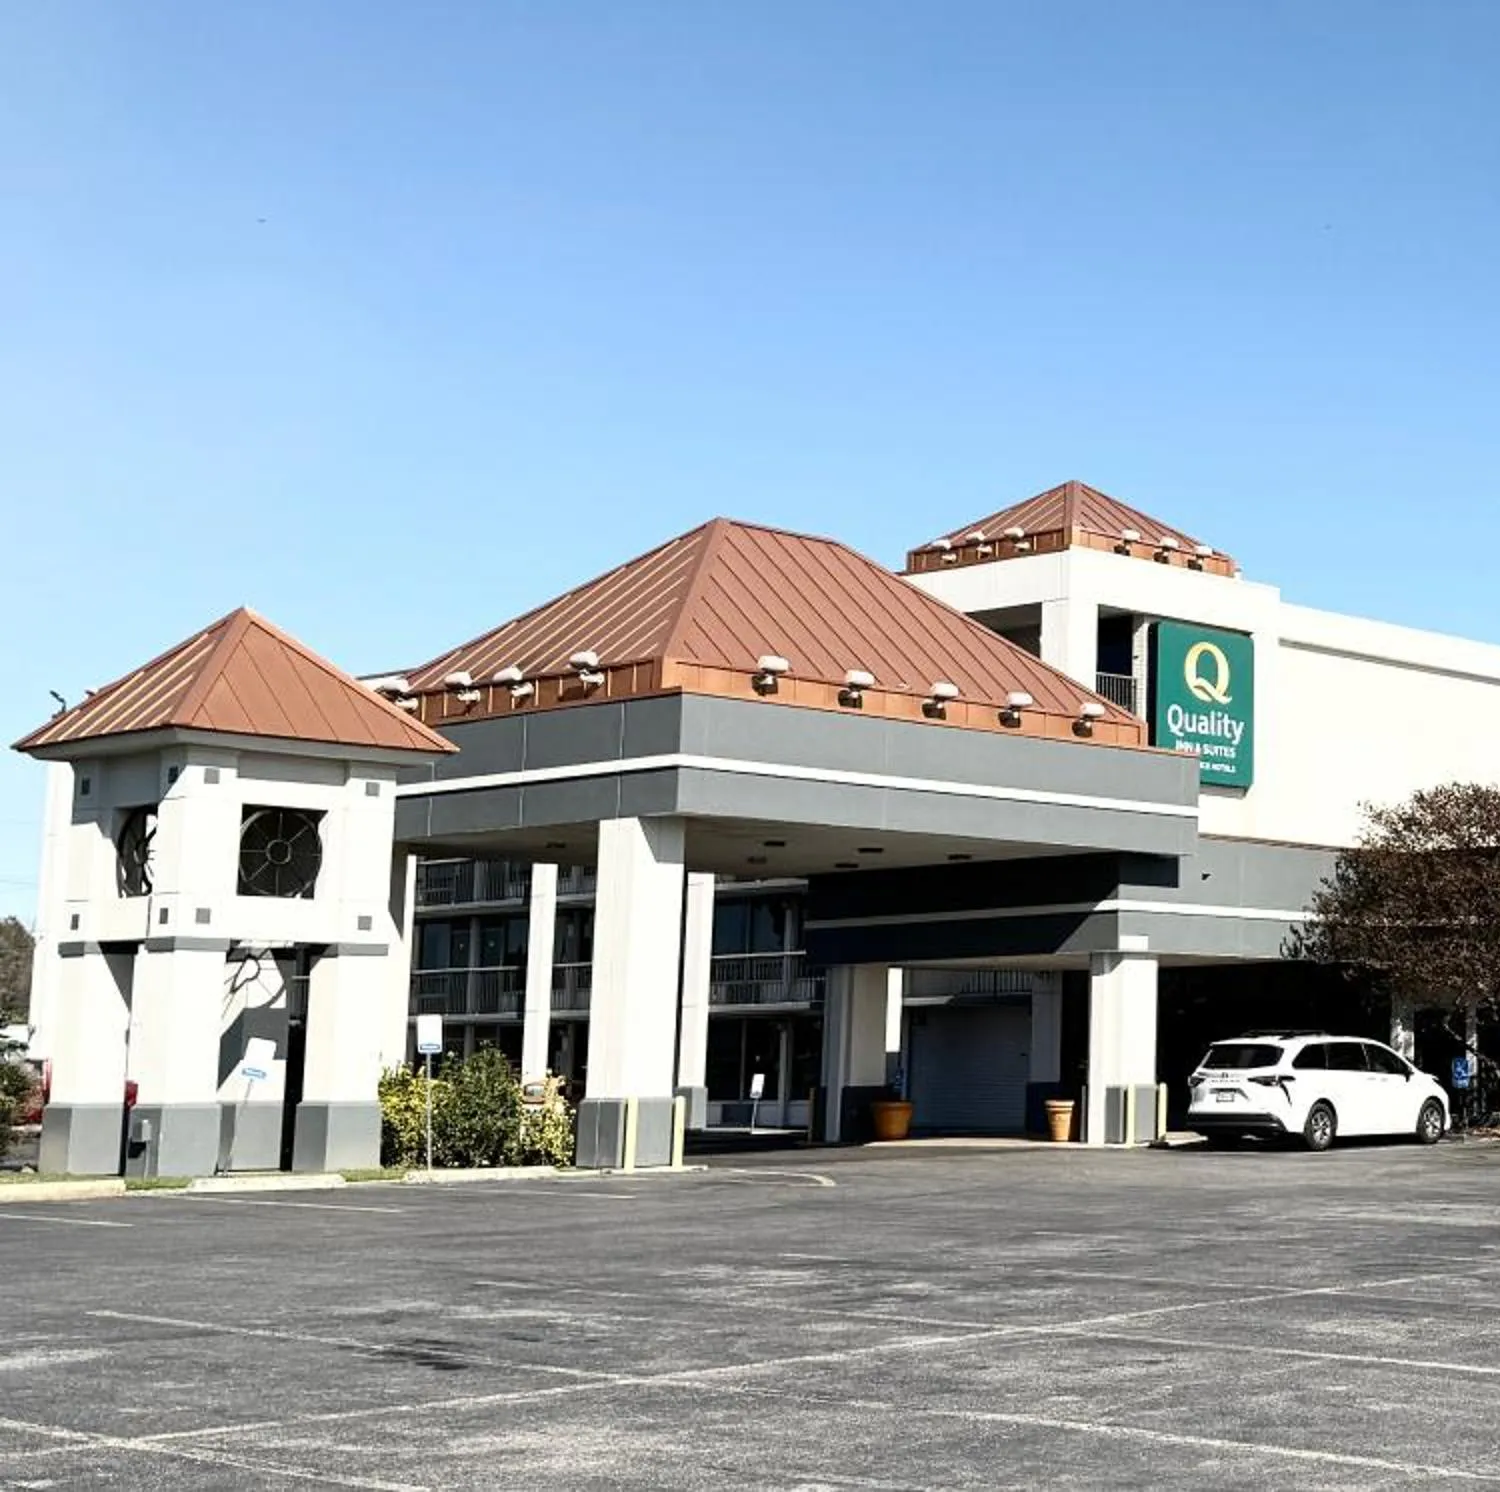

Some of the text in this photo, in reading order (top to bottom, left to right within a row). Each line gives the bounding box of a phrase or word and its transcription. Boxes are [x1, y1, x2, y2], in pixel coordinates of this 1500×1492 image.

[1184, 641, 1233, 704] Q
[1167, 703, 1245, 745] Quality
[1202, 743, 1236, 758] SUITES
